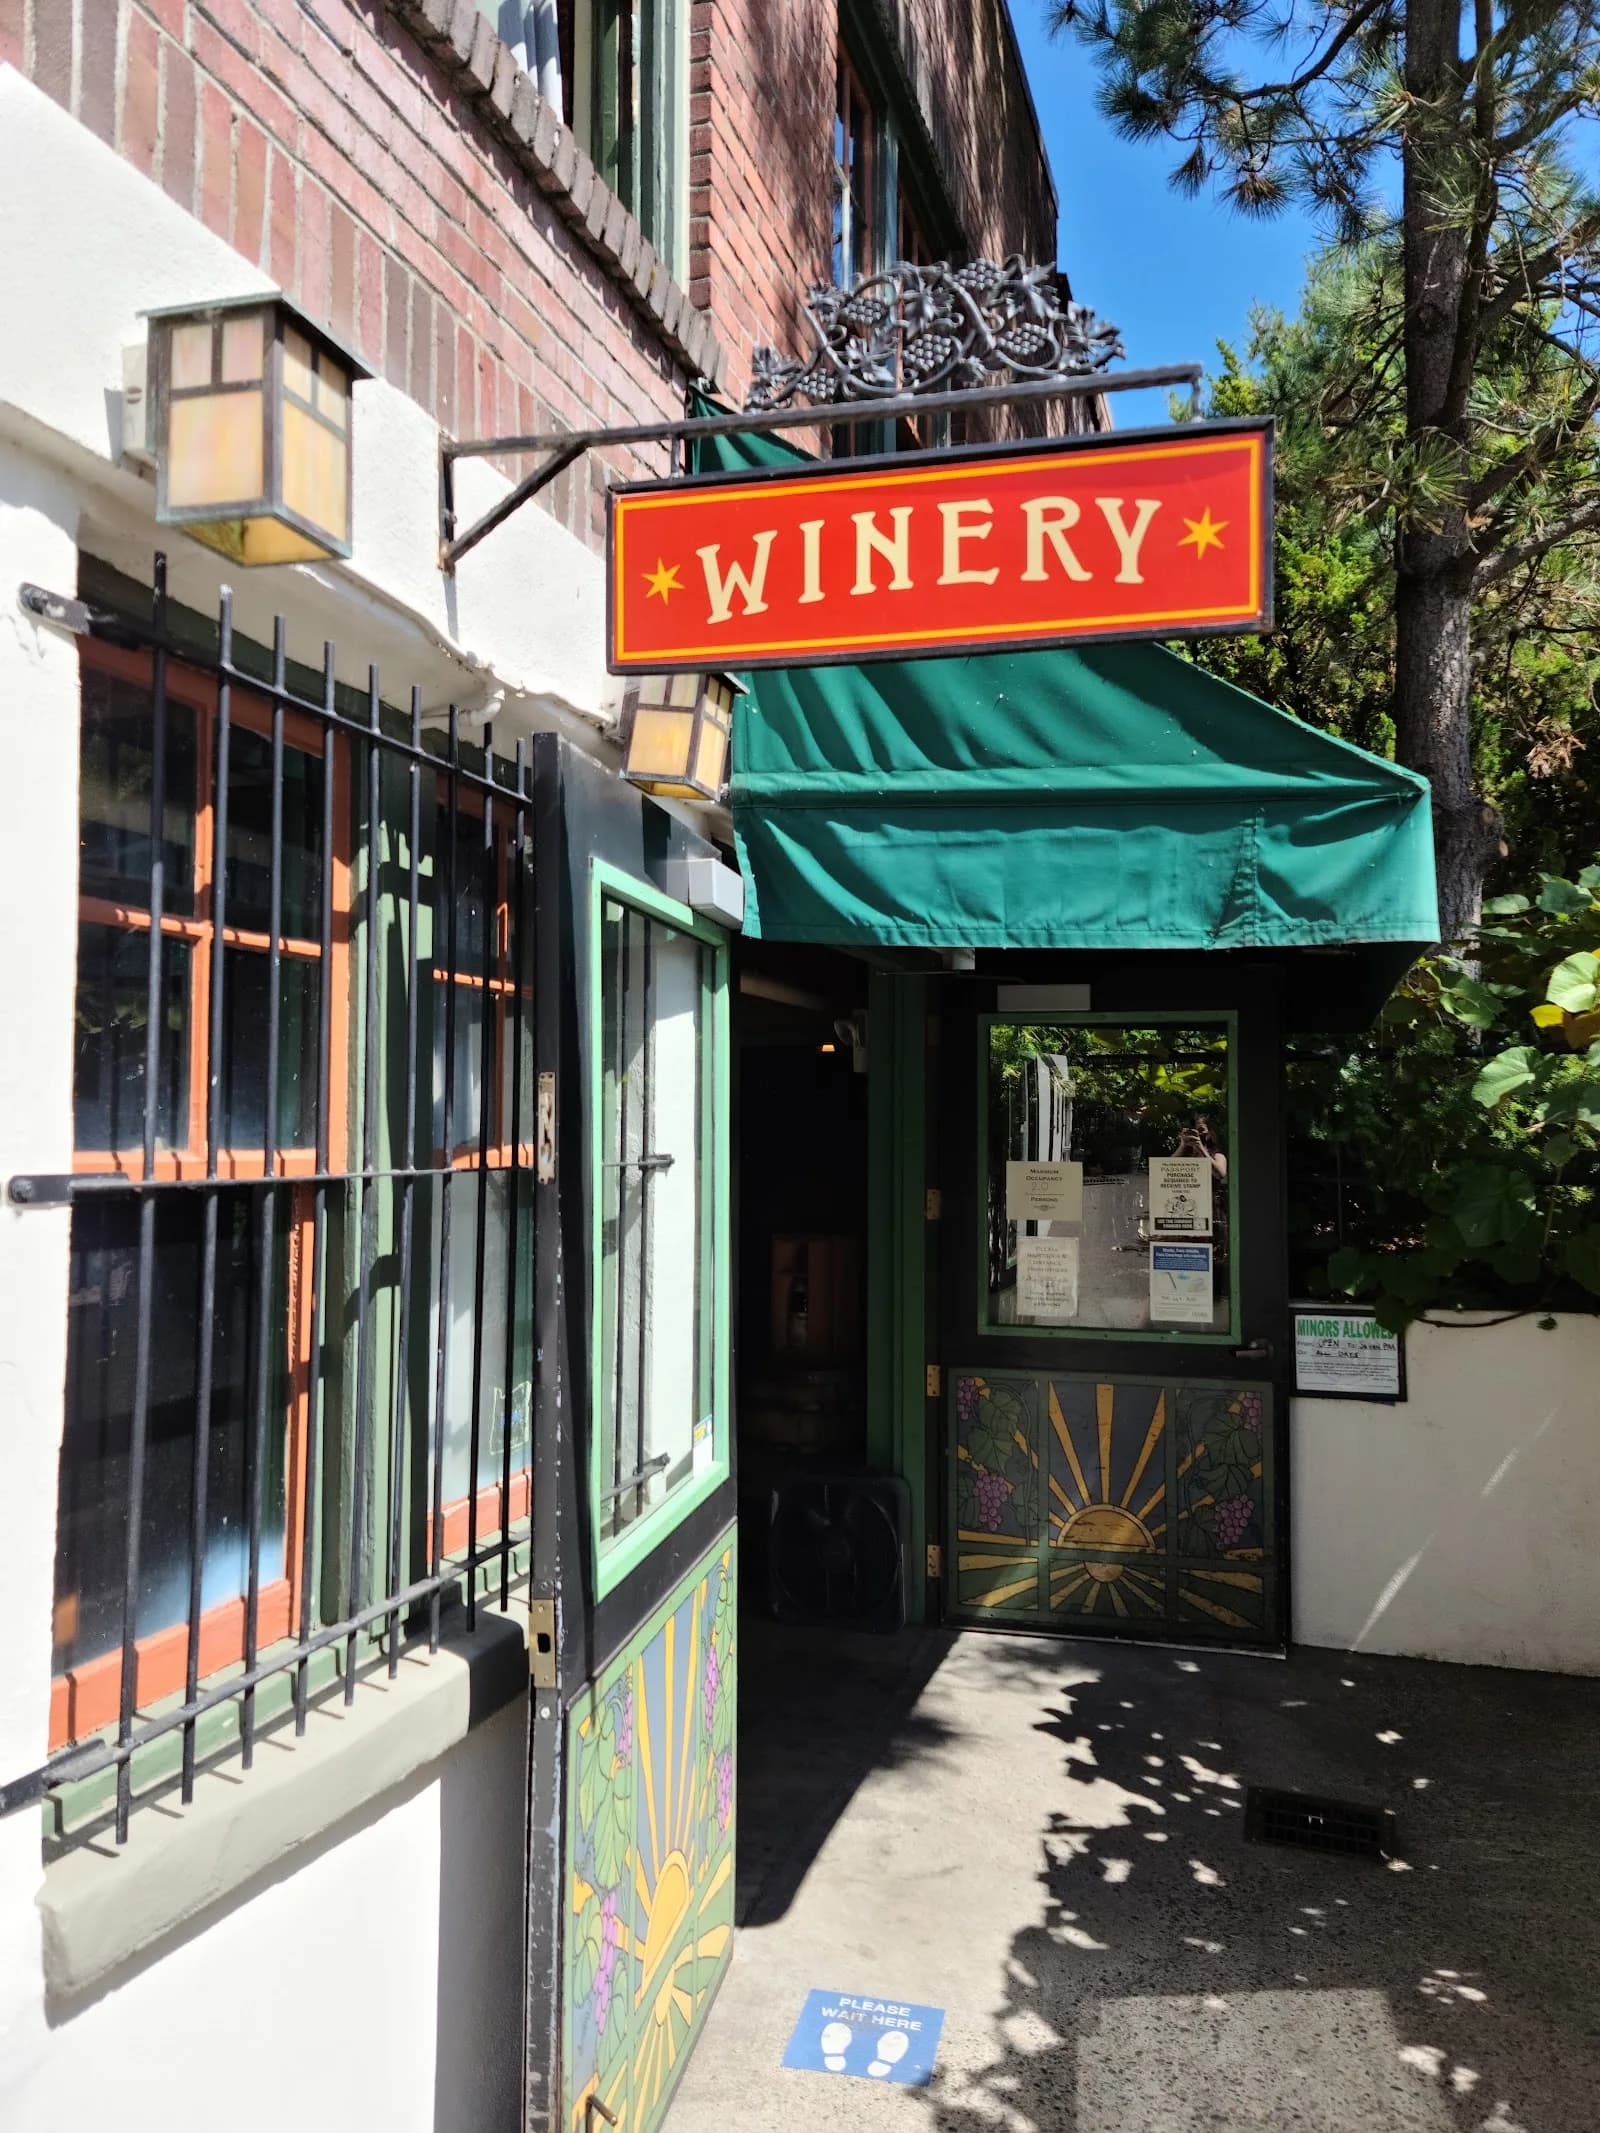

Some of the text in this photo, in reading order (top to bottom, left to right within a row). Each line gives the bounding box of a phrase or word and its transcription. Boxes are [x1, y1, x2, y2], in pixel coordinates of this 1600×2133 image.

[695, 496, 1162, 625] WINERY
[1297, 1319, 1340, 1338] MINORS
[839, 1997, 912, 2017] PLEASE
[821, 2007, 923, 2032] WAIT HERE
